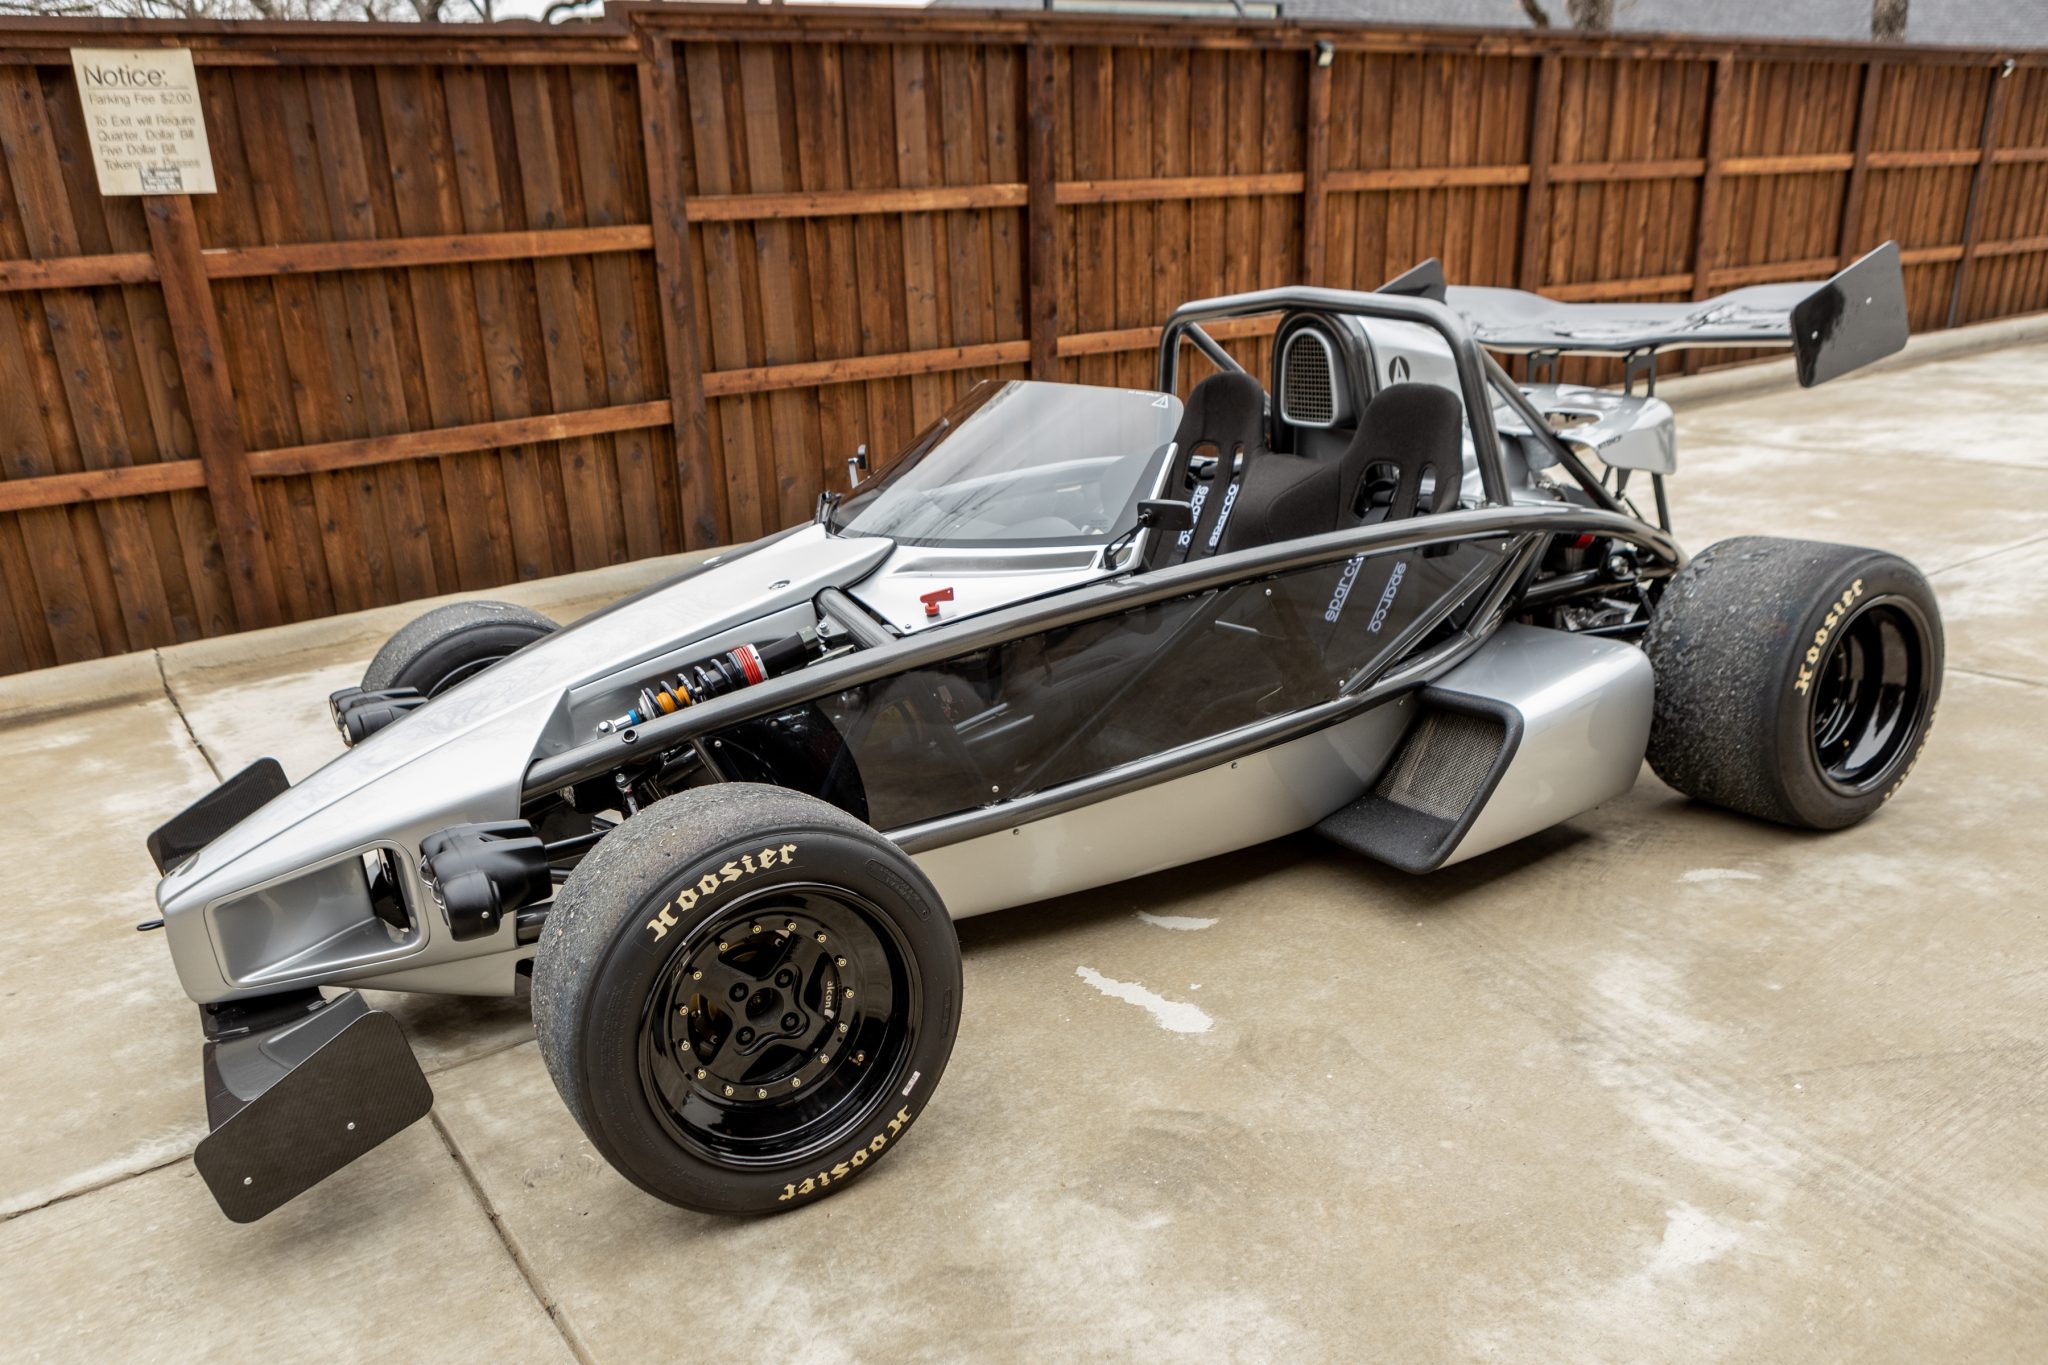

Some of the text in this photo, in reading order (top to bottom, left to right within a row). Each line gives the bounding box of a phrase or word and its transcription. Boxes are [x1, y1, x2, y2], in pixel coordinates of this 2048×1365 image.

[83, 64, 168, 87] Notice:
[88, 93, 131, 107] Parking
[134, 93, 156, 104] Fee
[94, 115, 107, 127] To
[111, 115, 132, 127] Exit
[145, 129, 175, 141] Dollar
[99, 144, 122, 156] Five
[127, 144, 156, 155] Dollar
[1209, 484, 1239, 546] sparco
[1367, 561, 1406, 632] sparco
[1794, 579, 1863, 696] Hoosier
[646, 843, 798, 942] Hoosier
[824, 980, 836, 1008] alcon
[778, 1104, 912, 1200] Hoosier
